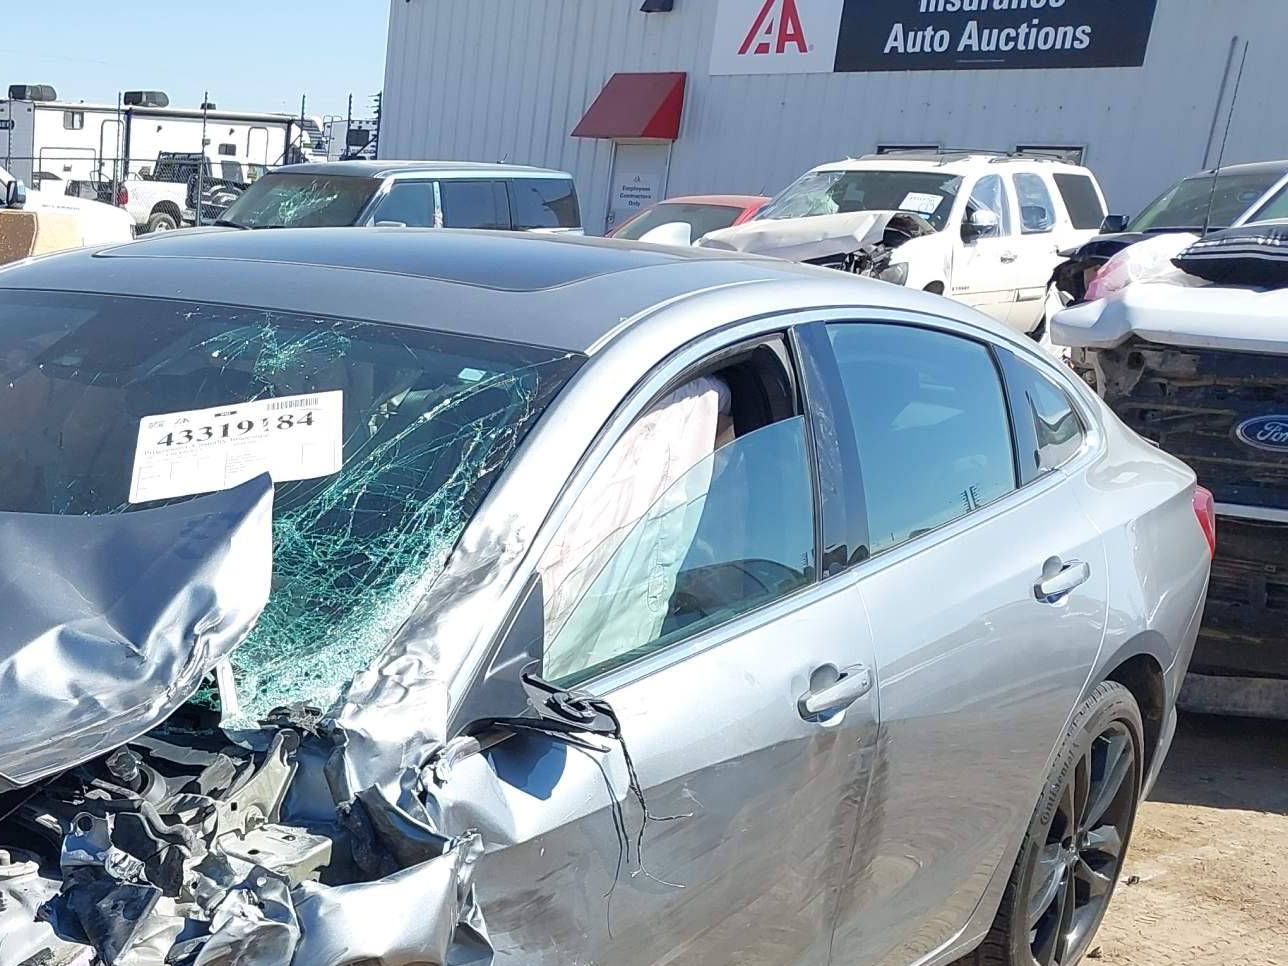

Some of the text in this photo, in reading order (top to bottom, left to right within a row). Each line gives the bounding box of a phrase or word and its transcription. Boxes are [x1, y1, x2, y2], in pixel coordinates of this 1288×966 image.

[884, 19, 1092, 54] Auto Auctions
[1040, 750, 1075, 826] Continental
